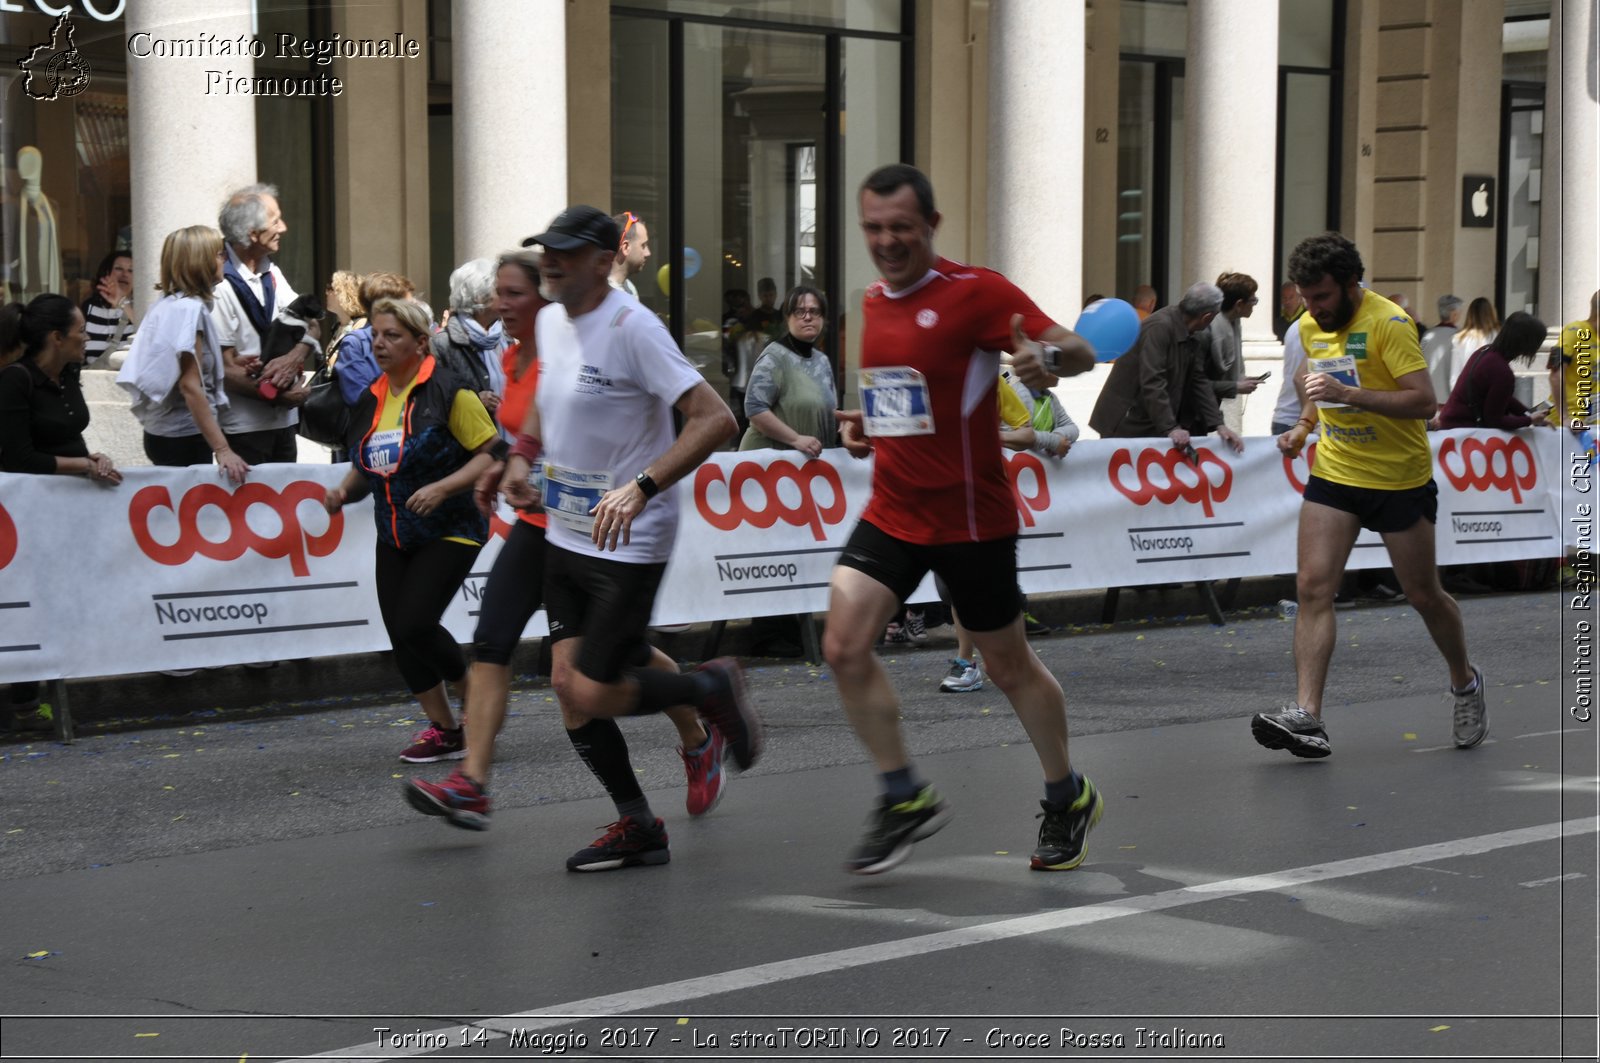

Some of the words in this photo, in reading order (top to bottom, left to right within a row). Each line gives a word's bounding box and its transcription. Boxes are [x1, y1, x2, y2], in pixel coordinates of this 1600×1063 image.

[1095, 127, 1109, 144] 82
[368, 449, 390, 468] 1307
[1438, 436, 1537, 504] coop
[1108, 447, 1233, 518] coop
[694, 459, 847, 541] coop
[129, 480, 345, 577] coop
[1452, 517, 1502, 536] Novacoop
[1129, 534, 1194, 552] Novacoop
[717, 561, 798, 582] Novacoop
[155, 602, 268, 624] Novacoop
